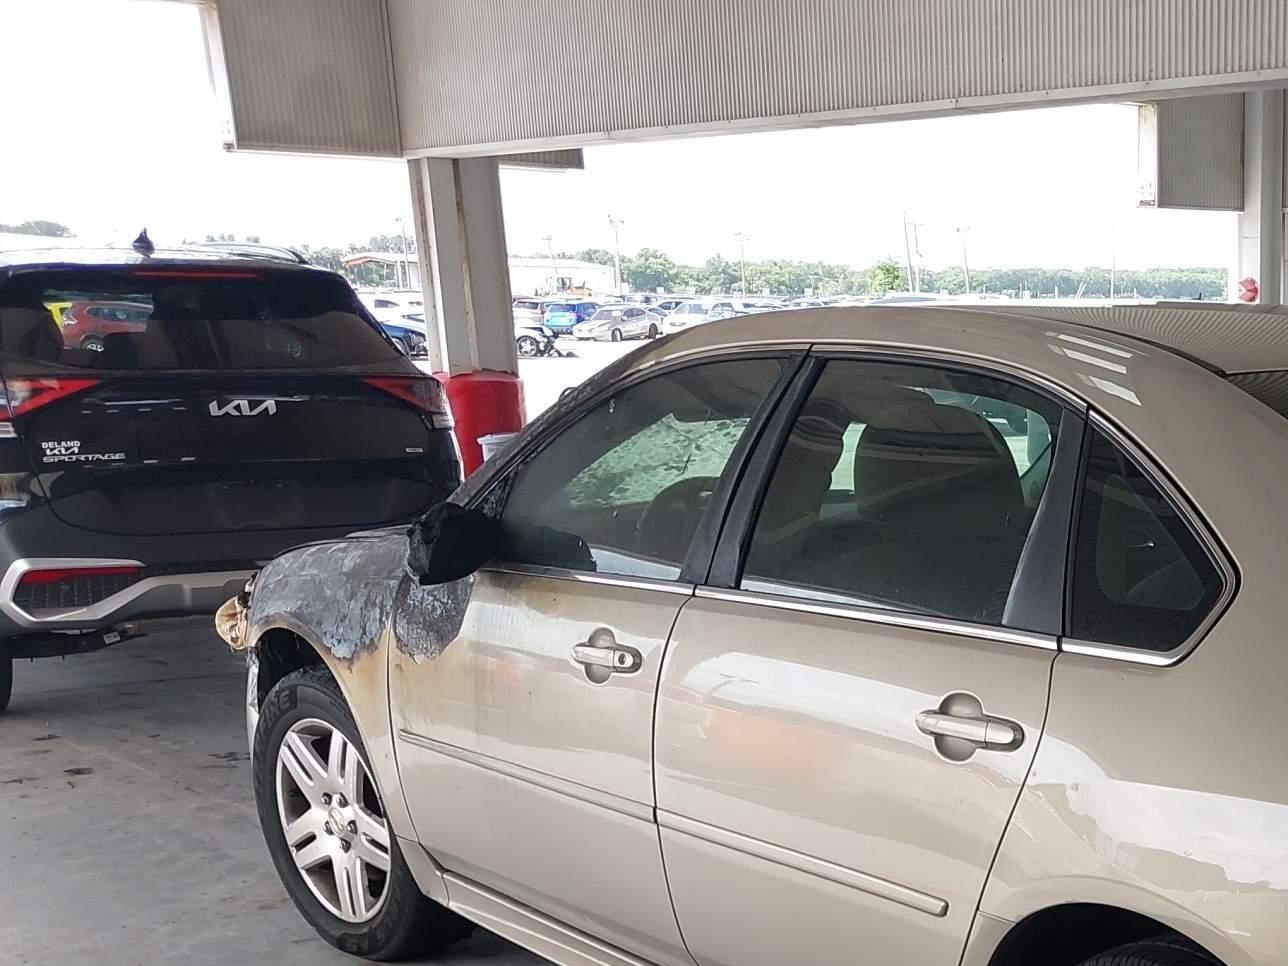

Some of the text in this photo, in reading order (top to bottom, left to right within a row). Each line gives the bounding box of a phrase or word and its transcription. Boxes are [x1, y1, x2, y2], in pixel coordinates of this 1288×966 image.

[209, 399, 278, 416] KIA
[42, 441, 81, 449] DELAND
[43, 453, 126, 463] SPORTAGE
